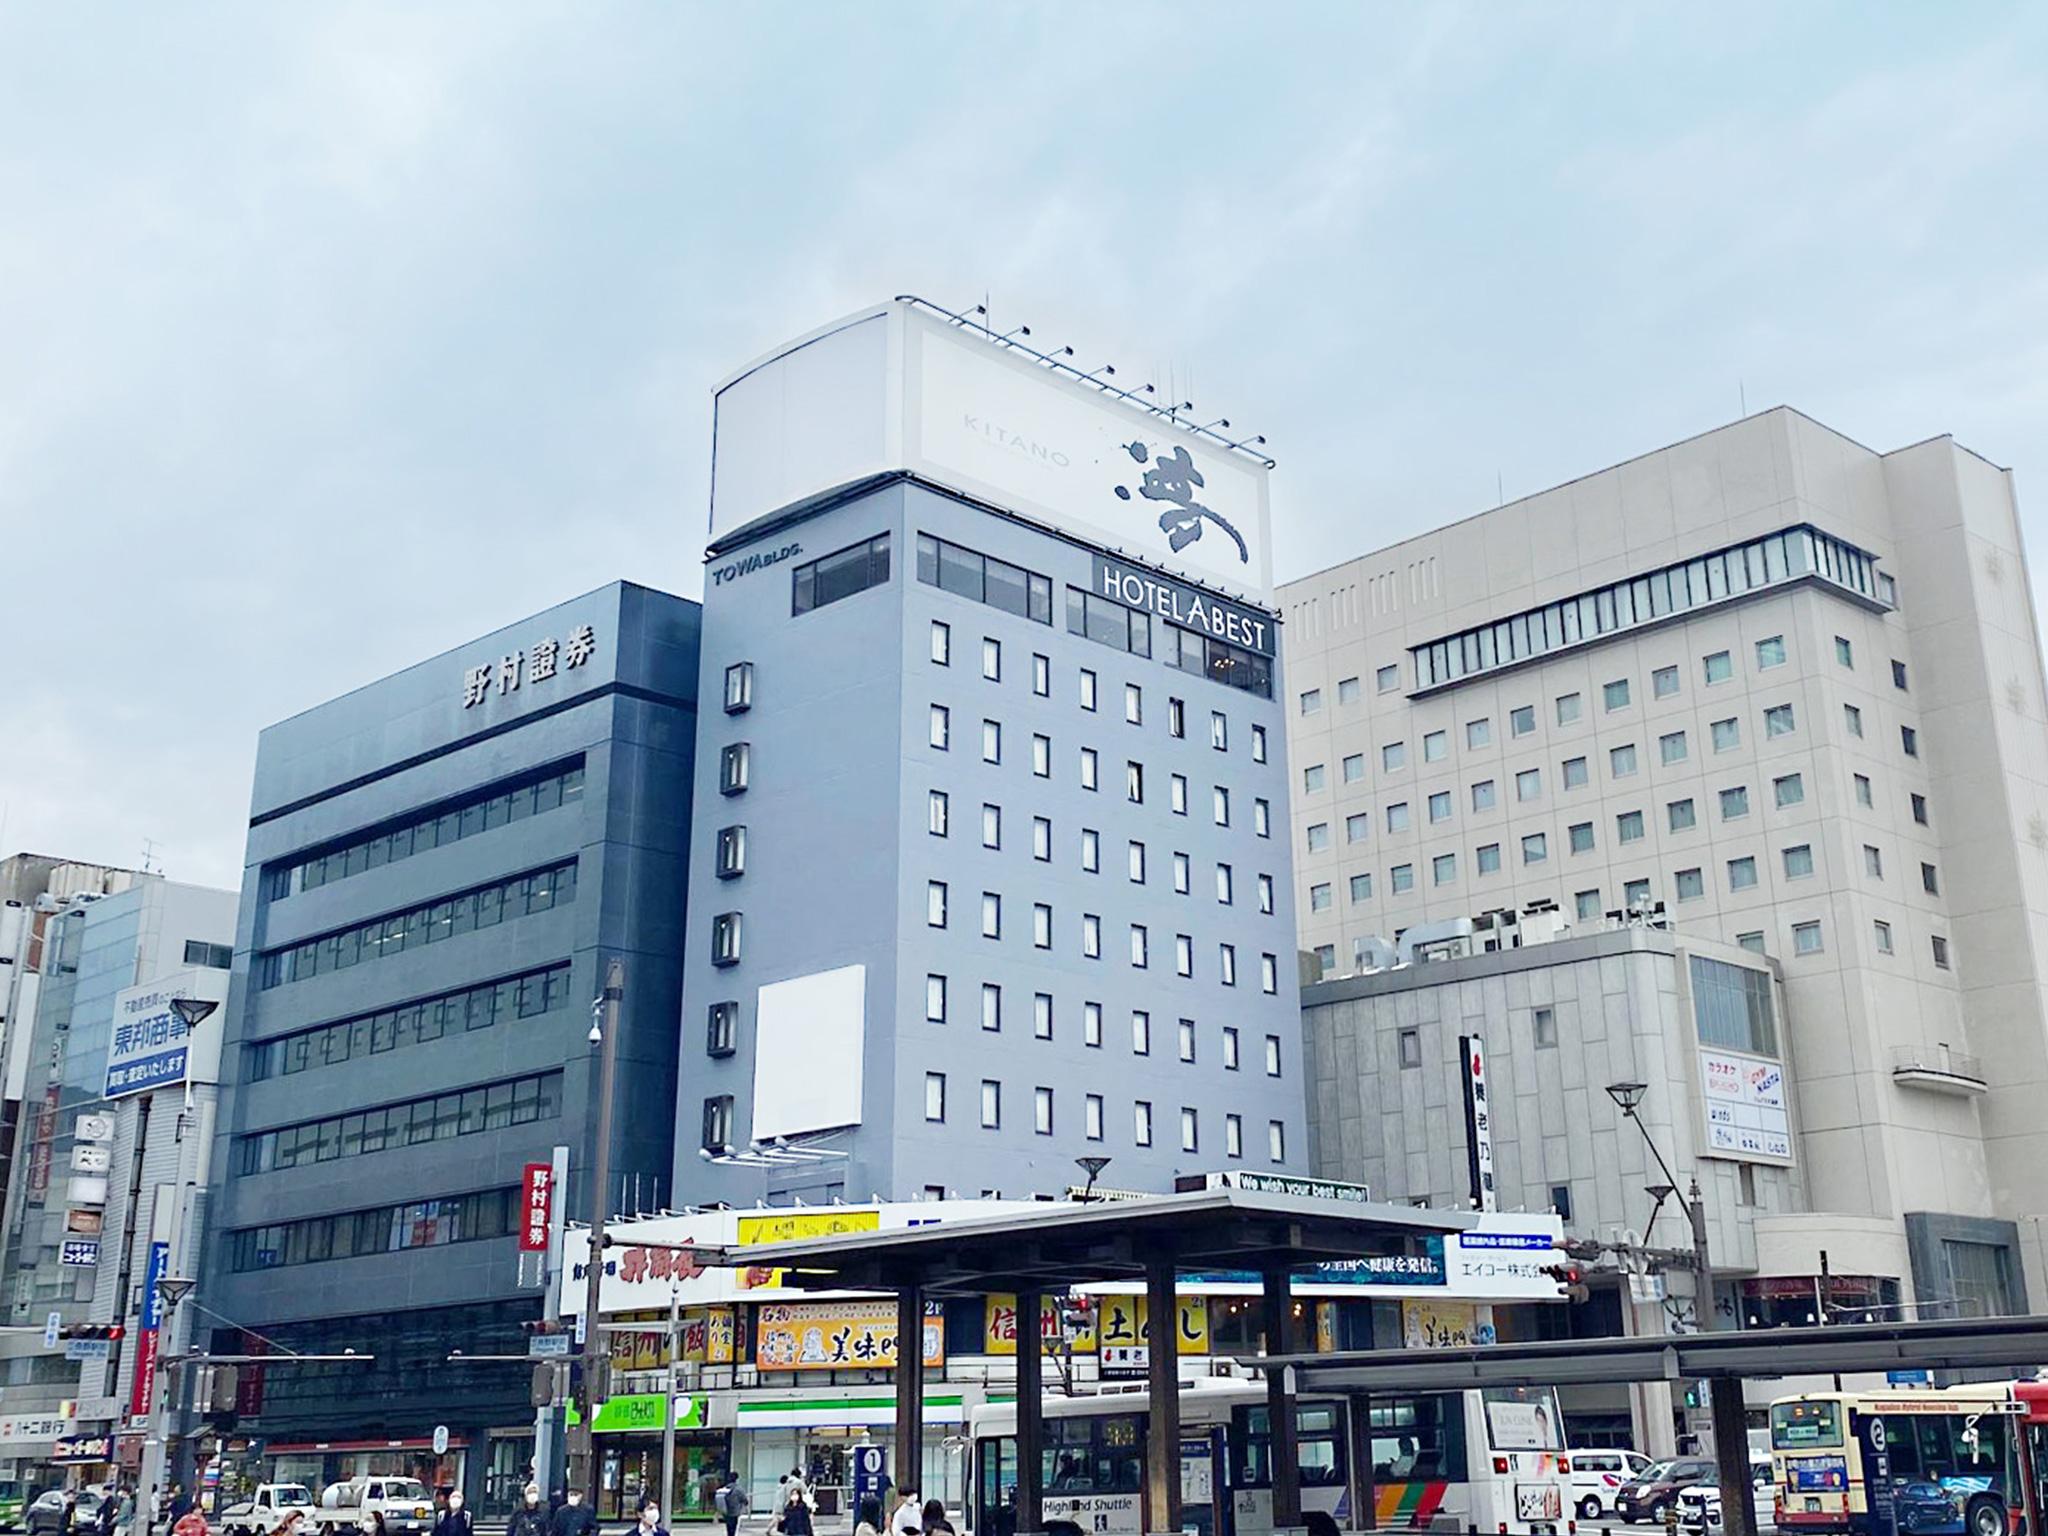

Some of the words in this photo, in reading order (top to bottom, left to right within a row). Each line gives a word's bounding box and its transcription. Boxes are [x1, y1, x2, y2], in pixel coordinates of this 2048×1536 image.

[963, 413, 1070, 467] KITANO
[463, 624, 595, 709] 野村證券
[114, 1012, 186, 1056] 東邦商事
[1474, 1082, 1495, 1192] 養老乃瀧
[529, 1170, 549, 1245] 野村證券
[1241, 1176, 1258, 1190] We
[1260, 1179, 1285, 1193] wish
[1286, 1183, 1309, 1196] your
[1312, 1184, 1335, 1199] best
[16, 1420, 65, 1435] 八十二銀行
[1044, 1500, 1091, 1516] Highlnd
[1094, 1499, 1132, 1511] Shuttle
